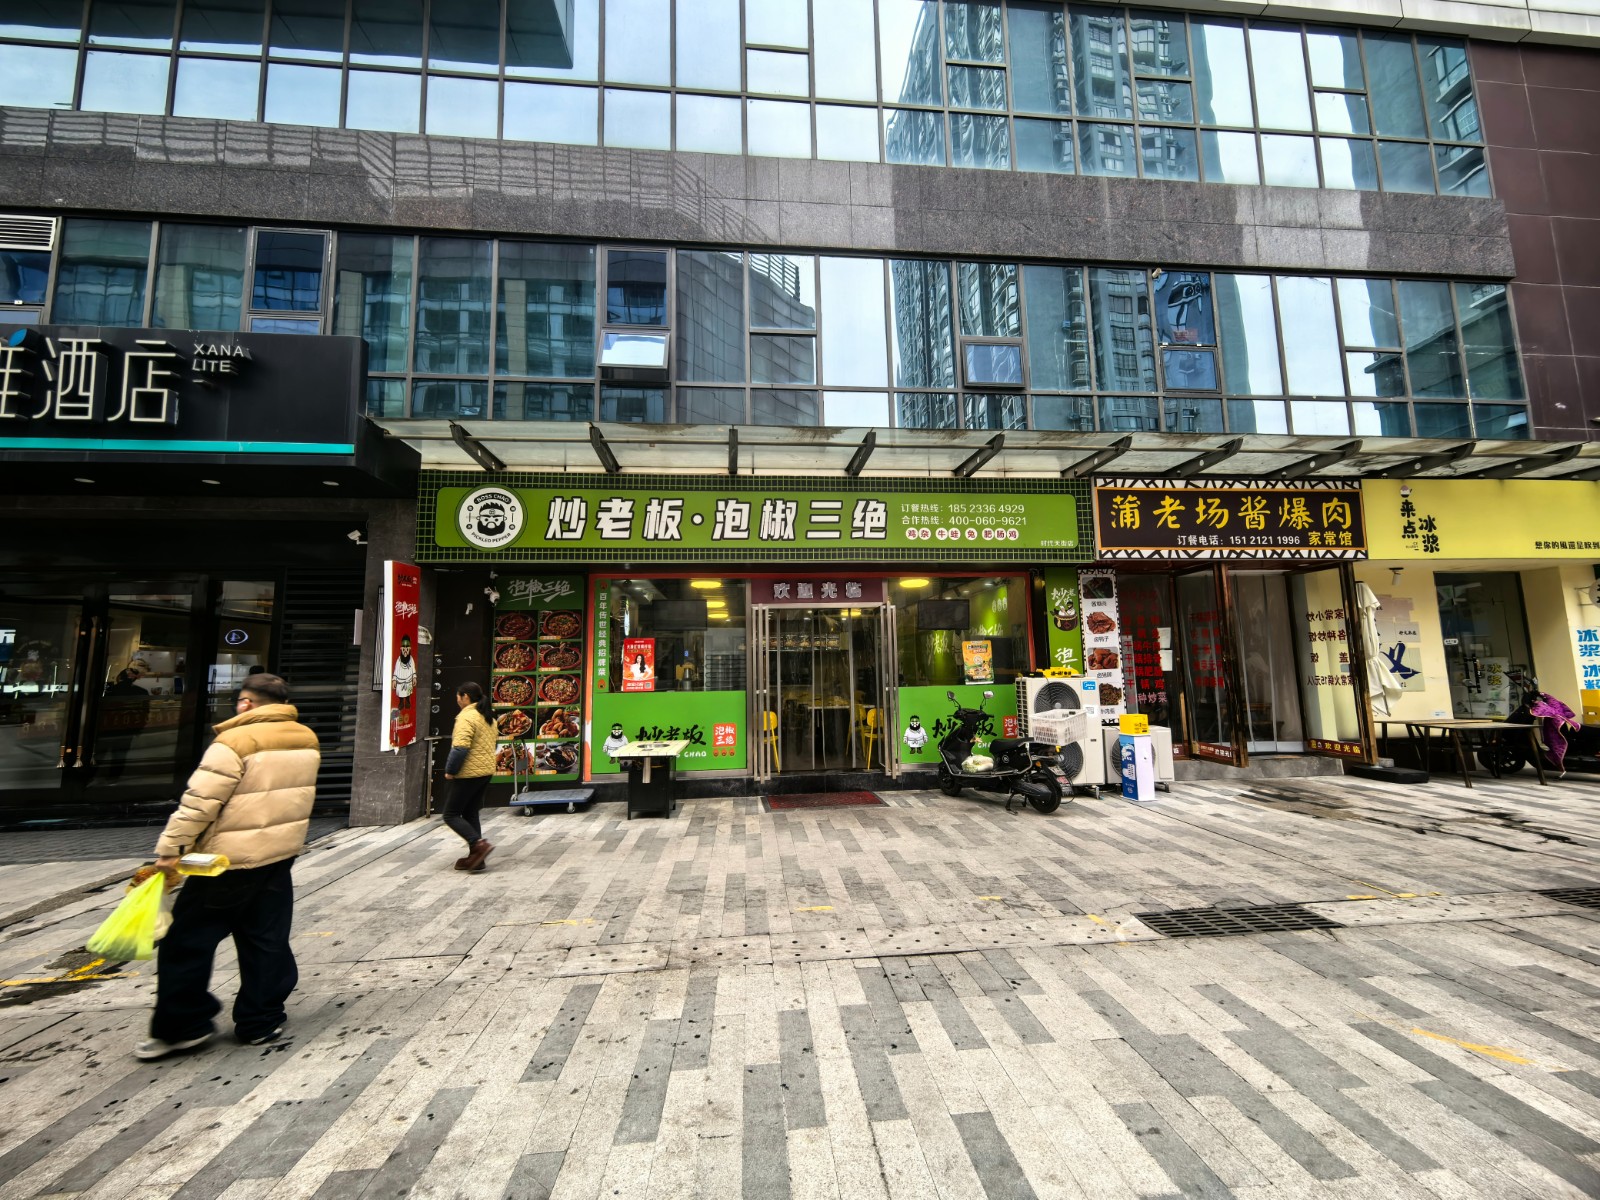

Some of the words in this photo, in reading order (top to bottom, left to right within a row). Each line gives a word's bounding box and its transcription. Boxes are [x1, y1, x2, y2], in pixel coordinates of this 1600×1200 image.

[193, 343, 244, 357] XANA
[192, 359, 231, 372] LITE
[477, 494, 493, 502] BOSS
[901, 503, 944, 513] 订餐热线：
[948, 504, 967, 513] 185
[969, 504, 996, 514] 2336
[998, 504, 1025, 514] 4929
[1110, 494, 1352, 531] 蒲老场酱爆肉
[544, 496, 888, 541] 炒老板·泡椒三绝
[901, 516, 944, 525] 合作热线：
[948, 516, 1027, 526] 400-060-9621
[1400, 499, 1419, 540] 来点
[471, 531, 492, 543] PICKLED
[492, 532, 512, 543] PEPPER
[1177, 535, 1223, 546] 订餐电话：
[1230, 536, 1246, 545] 151
[1250, 536, 1273, 545] 2121
[1277, 536, 1300, 545] 1996
[1308, 531, 1353, 547] 家常馆
[1418, 514, 1440, 553] 冰浆
[773, 581, 862, 599] 欢迎光临
[932, 718, 998, 739] 炒板
